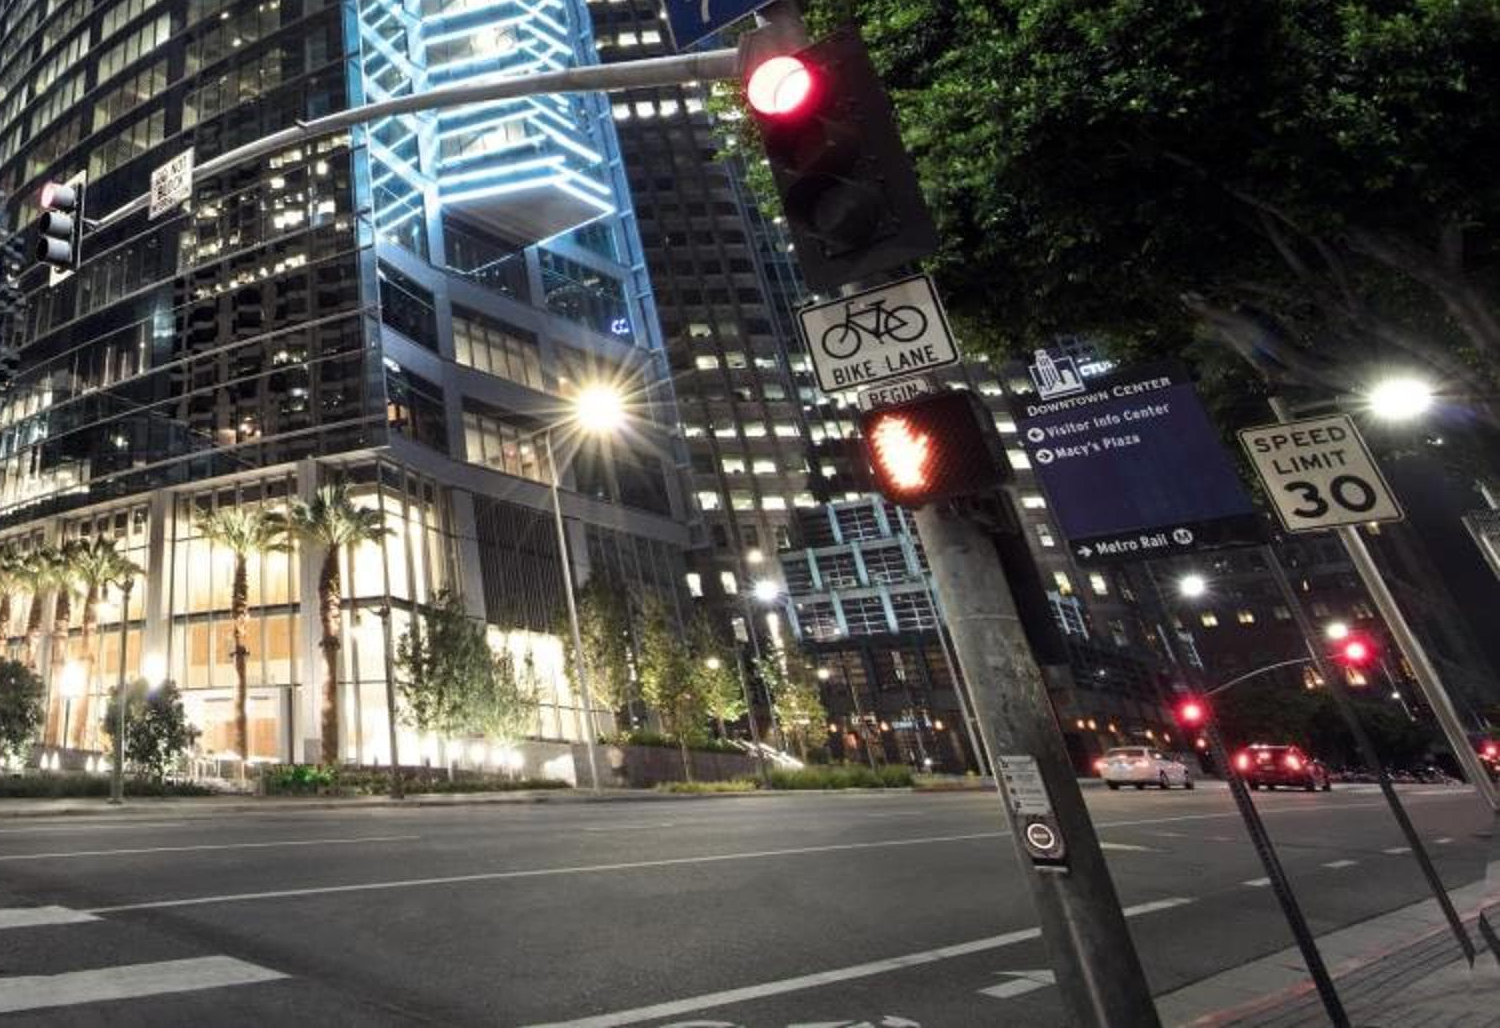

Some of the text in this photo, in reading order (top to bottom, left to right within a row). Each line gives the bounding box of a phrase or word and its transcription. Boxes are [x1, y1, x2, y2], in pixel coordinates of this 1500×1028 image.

[832, 344, 939, 385] BIKE LANE
[1045, 403, 1170, 439] Visitor Info Center
[1054, 434, 1141, 459] Macy's Plaza
[1253, 426, 1347, 453] SPEED
[1272, 450, 1346, 475] LIMIT
[1283, 474, 1377, 518] 30
[1095, 540, 1138, 554] Metro
[1140, 533, 1169, 548] Rail
